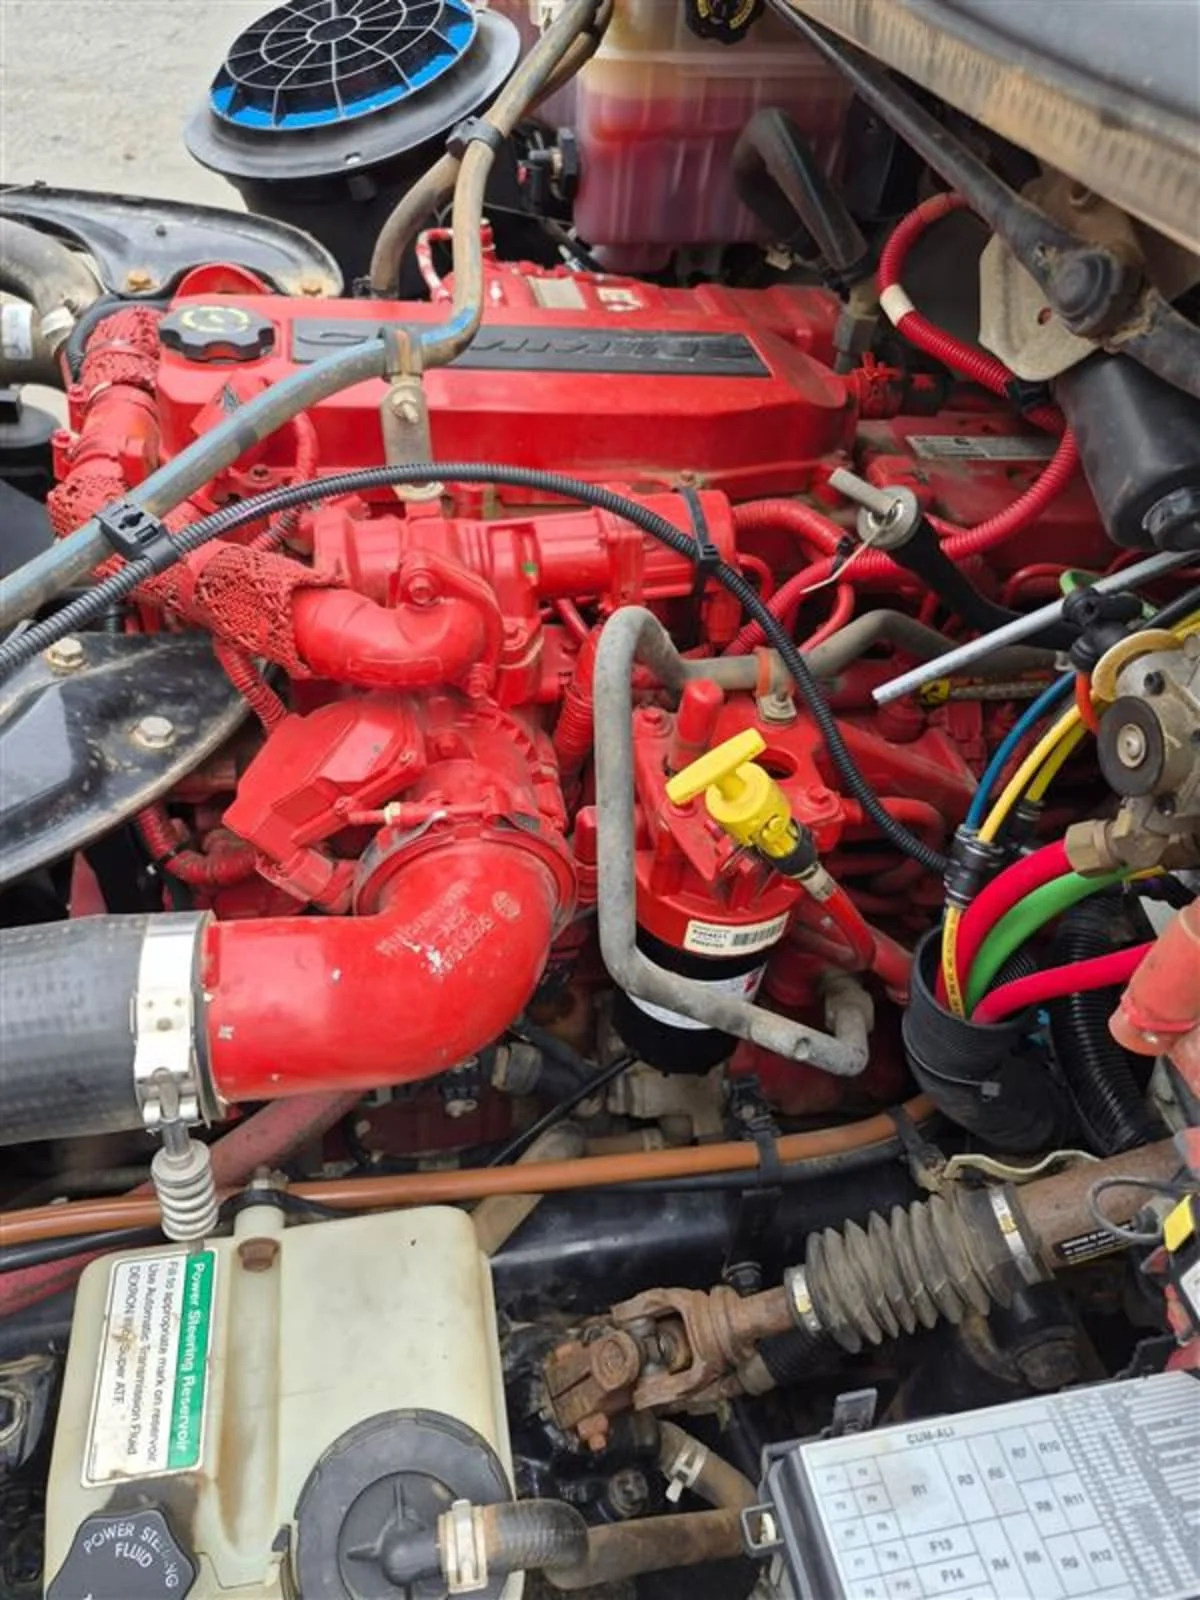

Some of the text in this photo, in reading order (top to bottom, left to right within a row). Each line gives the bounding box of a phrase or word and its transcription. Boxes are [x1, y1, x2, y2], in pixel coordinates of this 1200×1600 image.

[124, 1265, 141, 1314] DEXRON
[166, 1278, 176, 1289] to
[157, 1291, 174, 1354] appropriate
[115, 1343, 130, 1378] Super
[127, 1264, 160, 1455] Use Automatic Transmission Fluid
[155, 1357, 167, 1386] mark
[176, 1263, 205, 1452] Power Steering Reservoir
[153, 1389, 163, 1406] on
[83, 1523, 179, 1589] POWER STENG
[115, 1542, 152, 1568] FLUID
